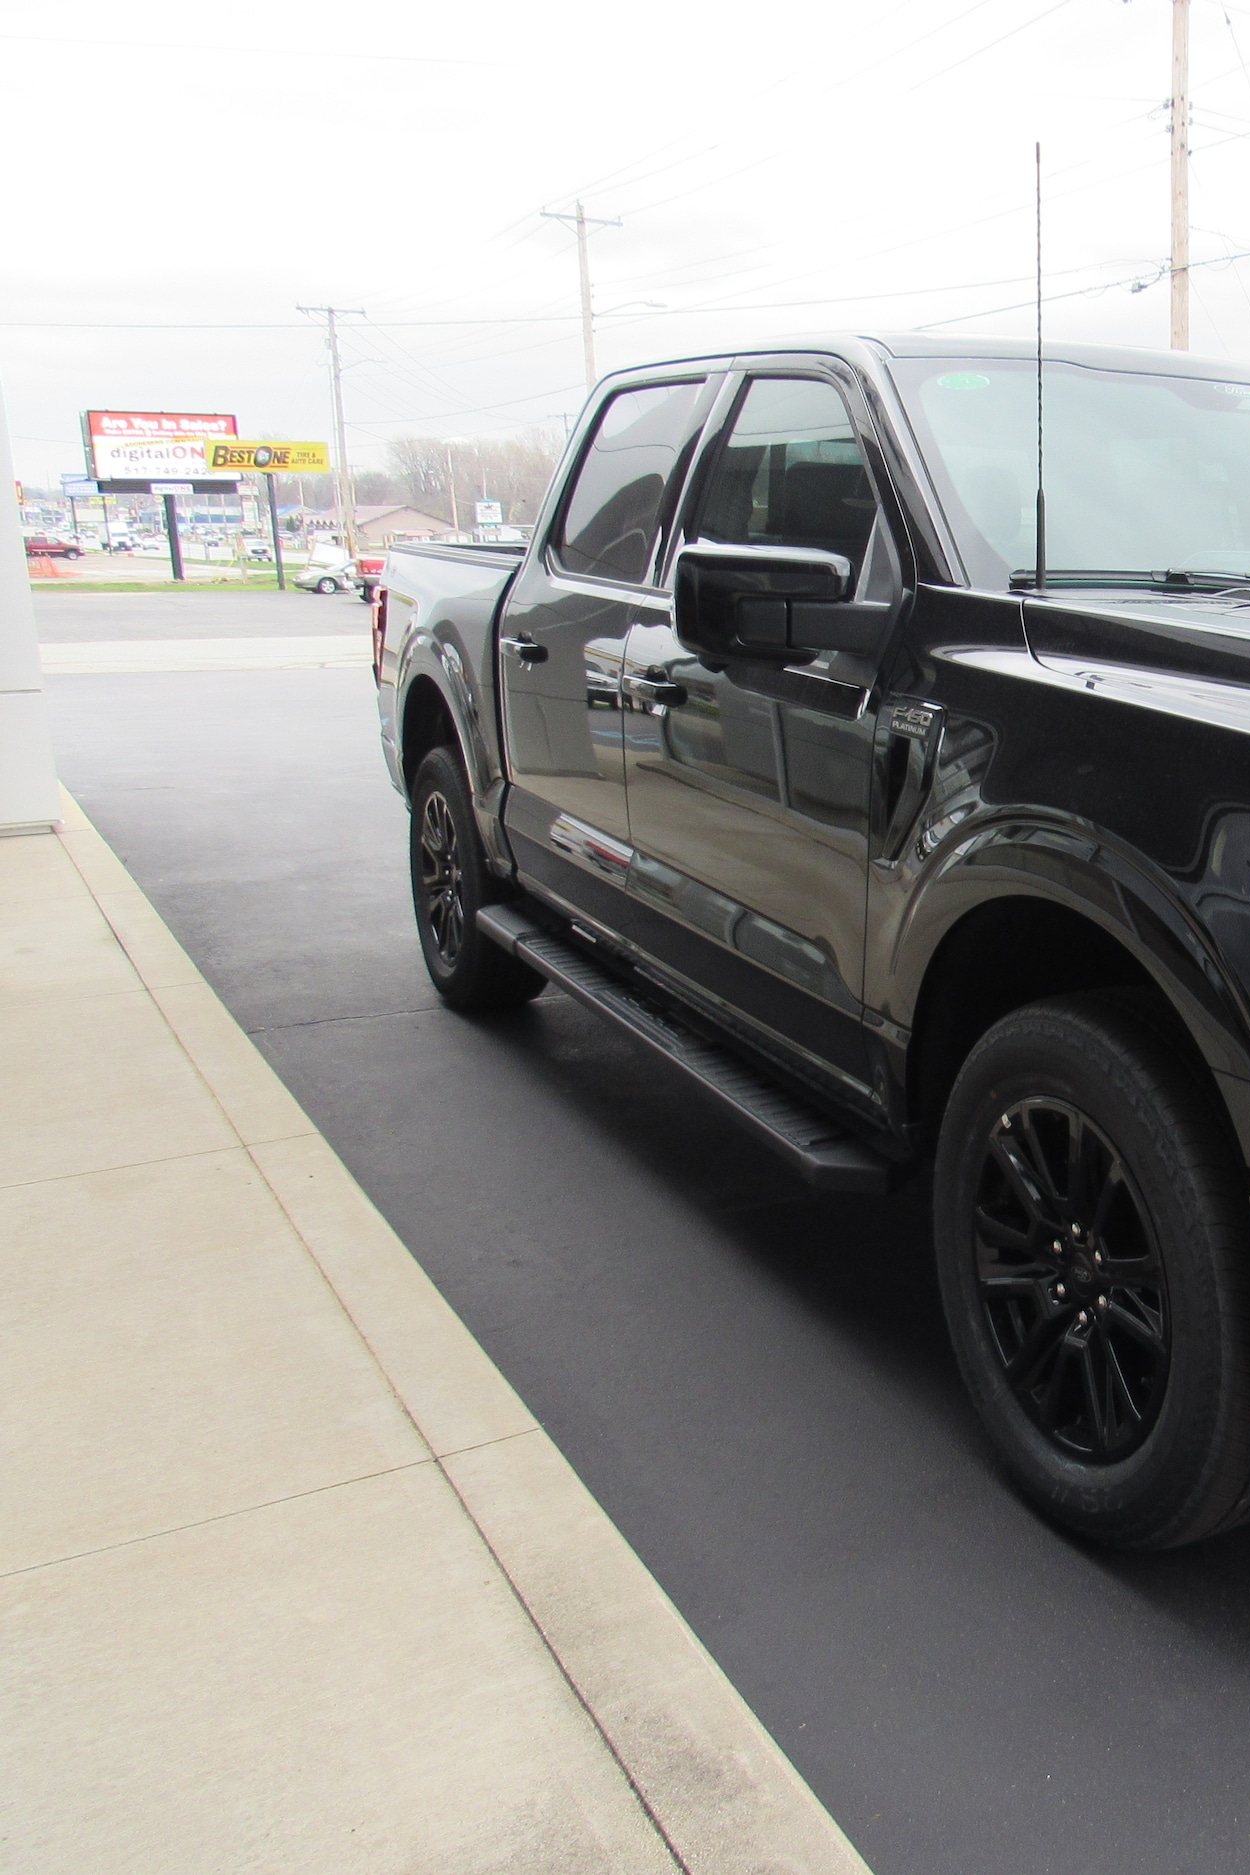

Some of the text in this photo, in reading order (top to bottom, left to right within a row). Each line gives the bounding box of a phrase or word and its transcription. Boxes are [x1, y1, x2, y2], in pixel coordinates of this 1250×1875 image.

[101, 417, 128, 429] Are
[130, 418, 159, 430] You
[179, 419, 227, 431] Sales?
[893, 706, 933, 726] F-150
[892, 721, 926, 736] PLATINUM
